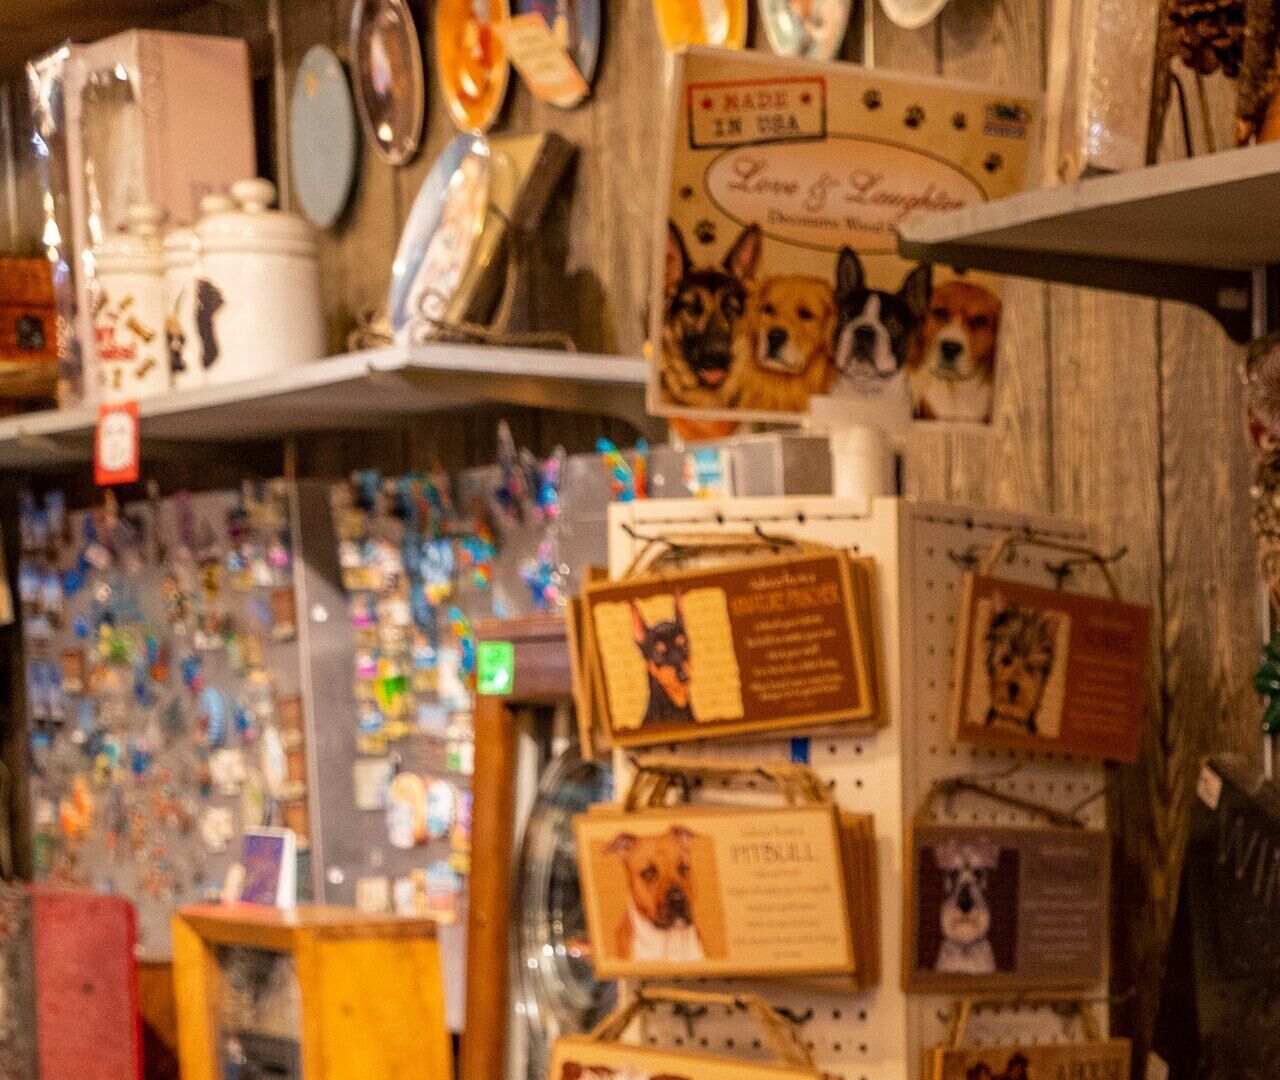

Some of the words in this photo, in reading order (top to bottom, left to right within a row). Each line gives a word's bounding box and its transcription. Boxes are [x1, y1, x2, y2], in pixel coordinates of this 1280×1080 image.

[722, 90, 789, 111] MADE
[713, 118, 742, 137] IN
[756, 113, 800, 134] USA
[728, 154, 800, 195] Love
[846, 168, 966, 219] Laughter
[730, 841, 819, 865] PITBULL
